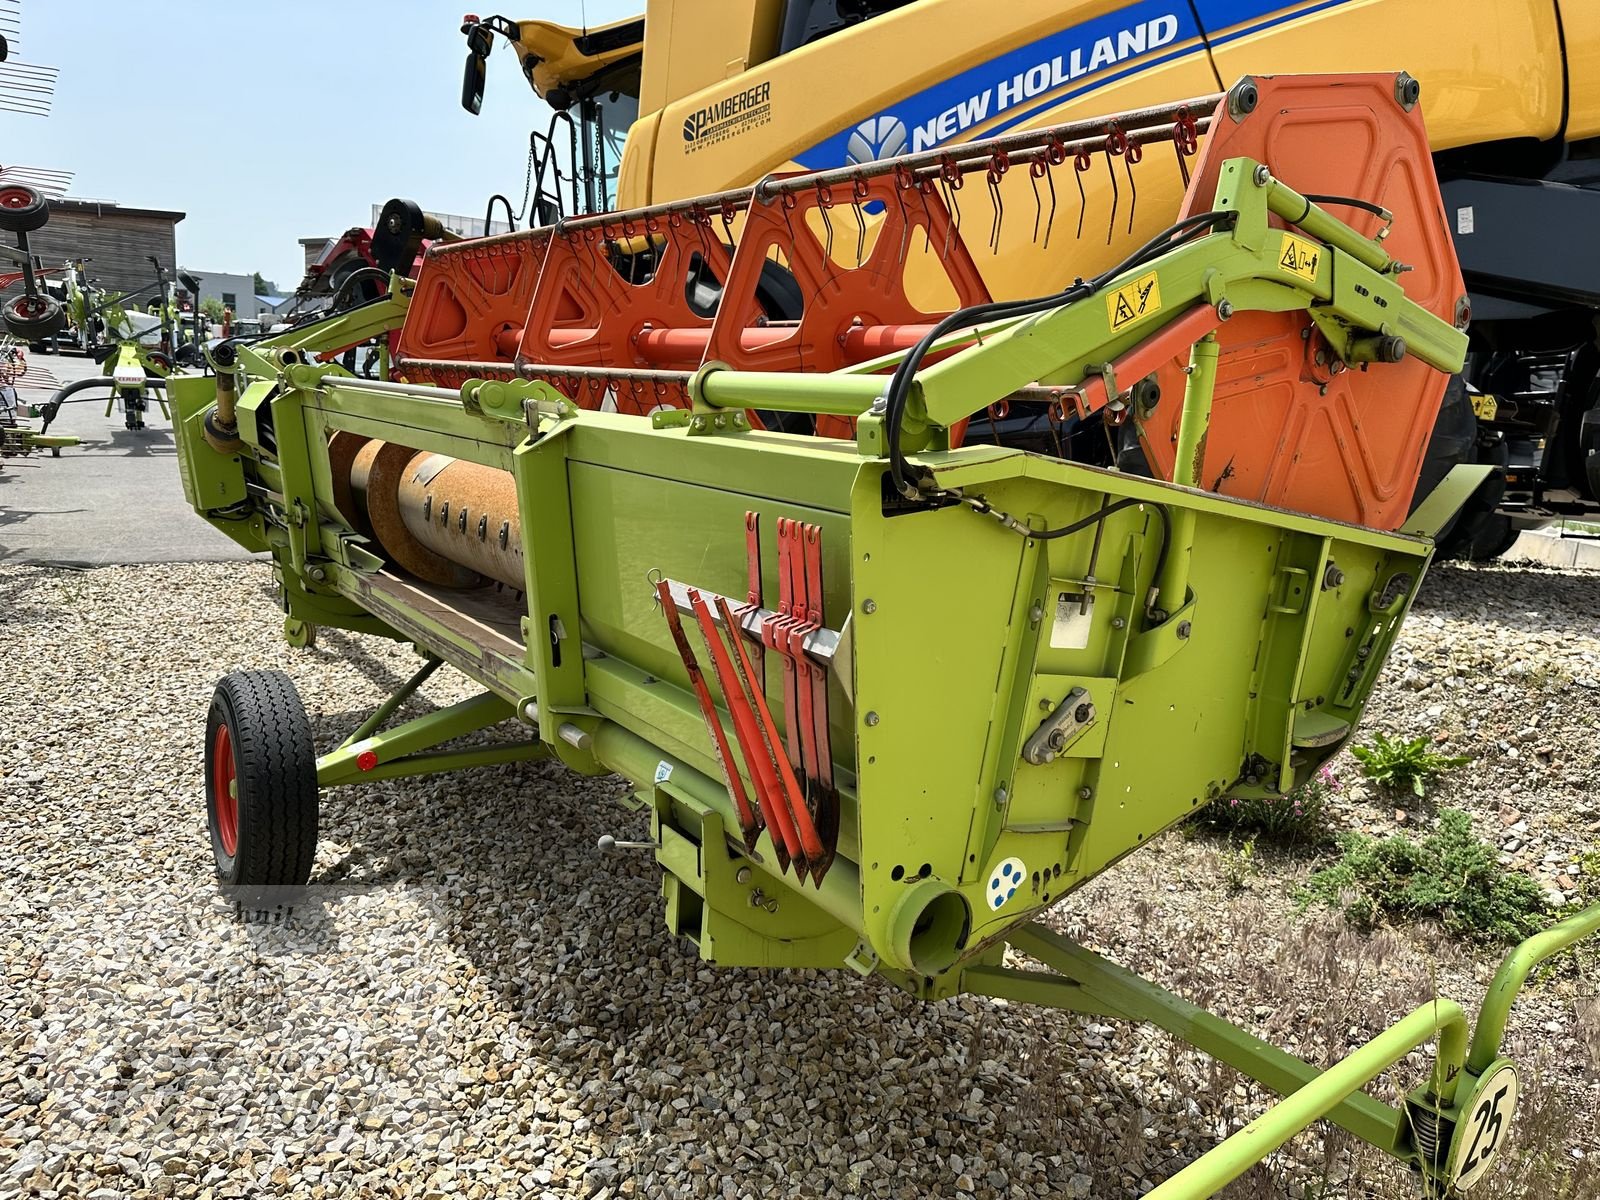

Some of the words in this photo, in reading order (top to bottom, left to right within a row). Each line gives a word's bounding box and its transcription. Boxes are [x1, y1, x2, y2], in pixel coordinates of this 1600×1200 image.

[695, 81, 770, 140] PAMBERGER
[912, 88, 992, 153] NEW
[997, 14, 1178, 111] HOLLAND
[1459, 1084, 1509, 1178] 25
